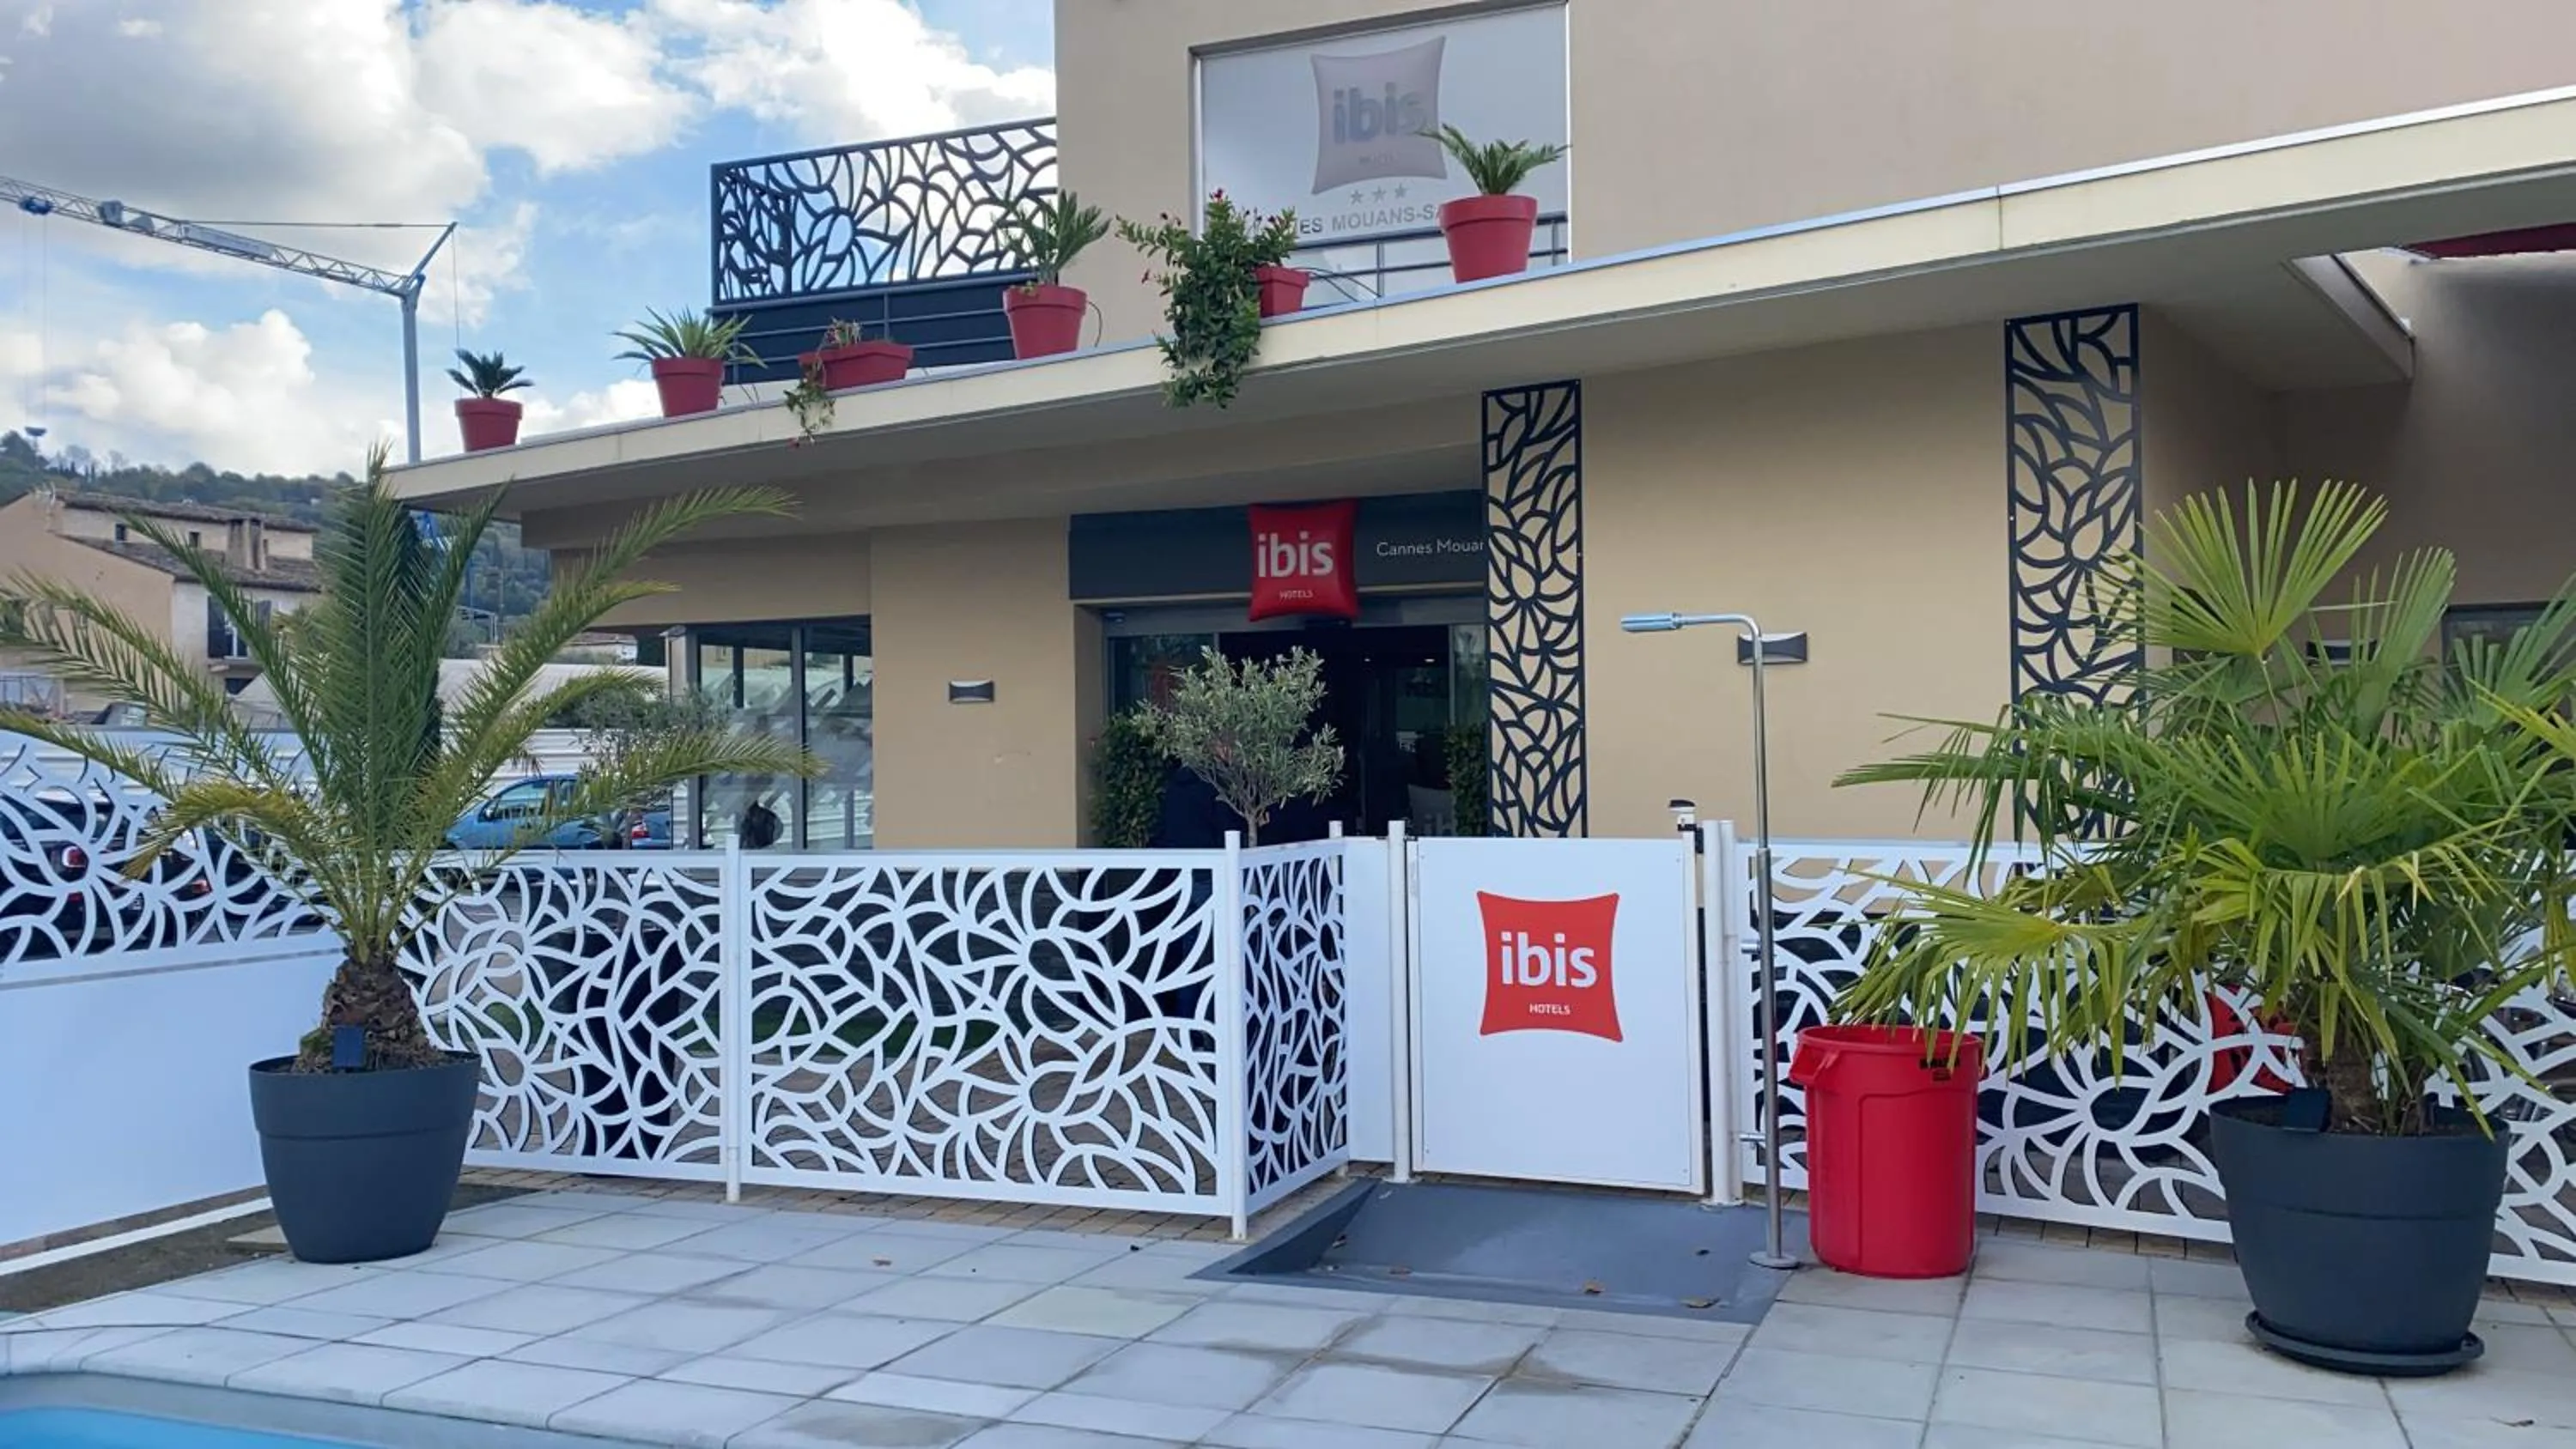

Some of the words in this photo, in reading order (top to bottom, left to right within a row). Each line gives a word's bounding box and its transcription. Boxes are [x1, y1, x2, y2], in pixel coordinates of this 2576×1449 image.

[1334, 82, 1427, 144] ibis
[1332, 203, 1438, 232] MOUANS-S
[1258, 530, 1334, 578] ibis
[1376, 542, 1433, 556] Cannes
[1501, 931, 1598, 988] ibis
[1529, 1003, 1571, 1015] HOTELS
